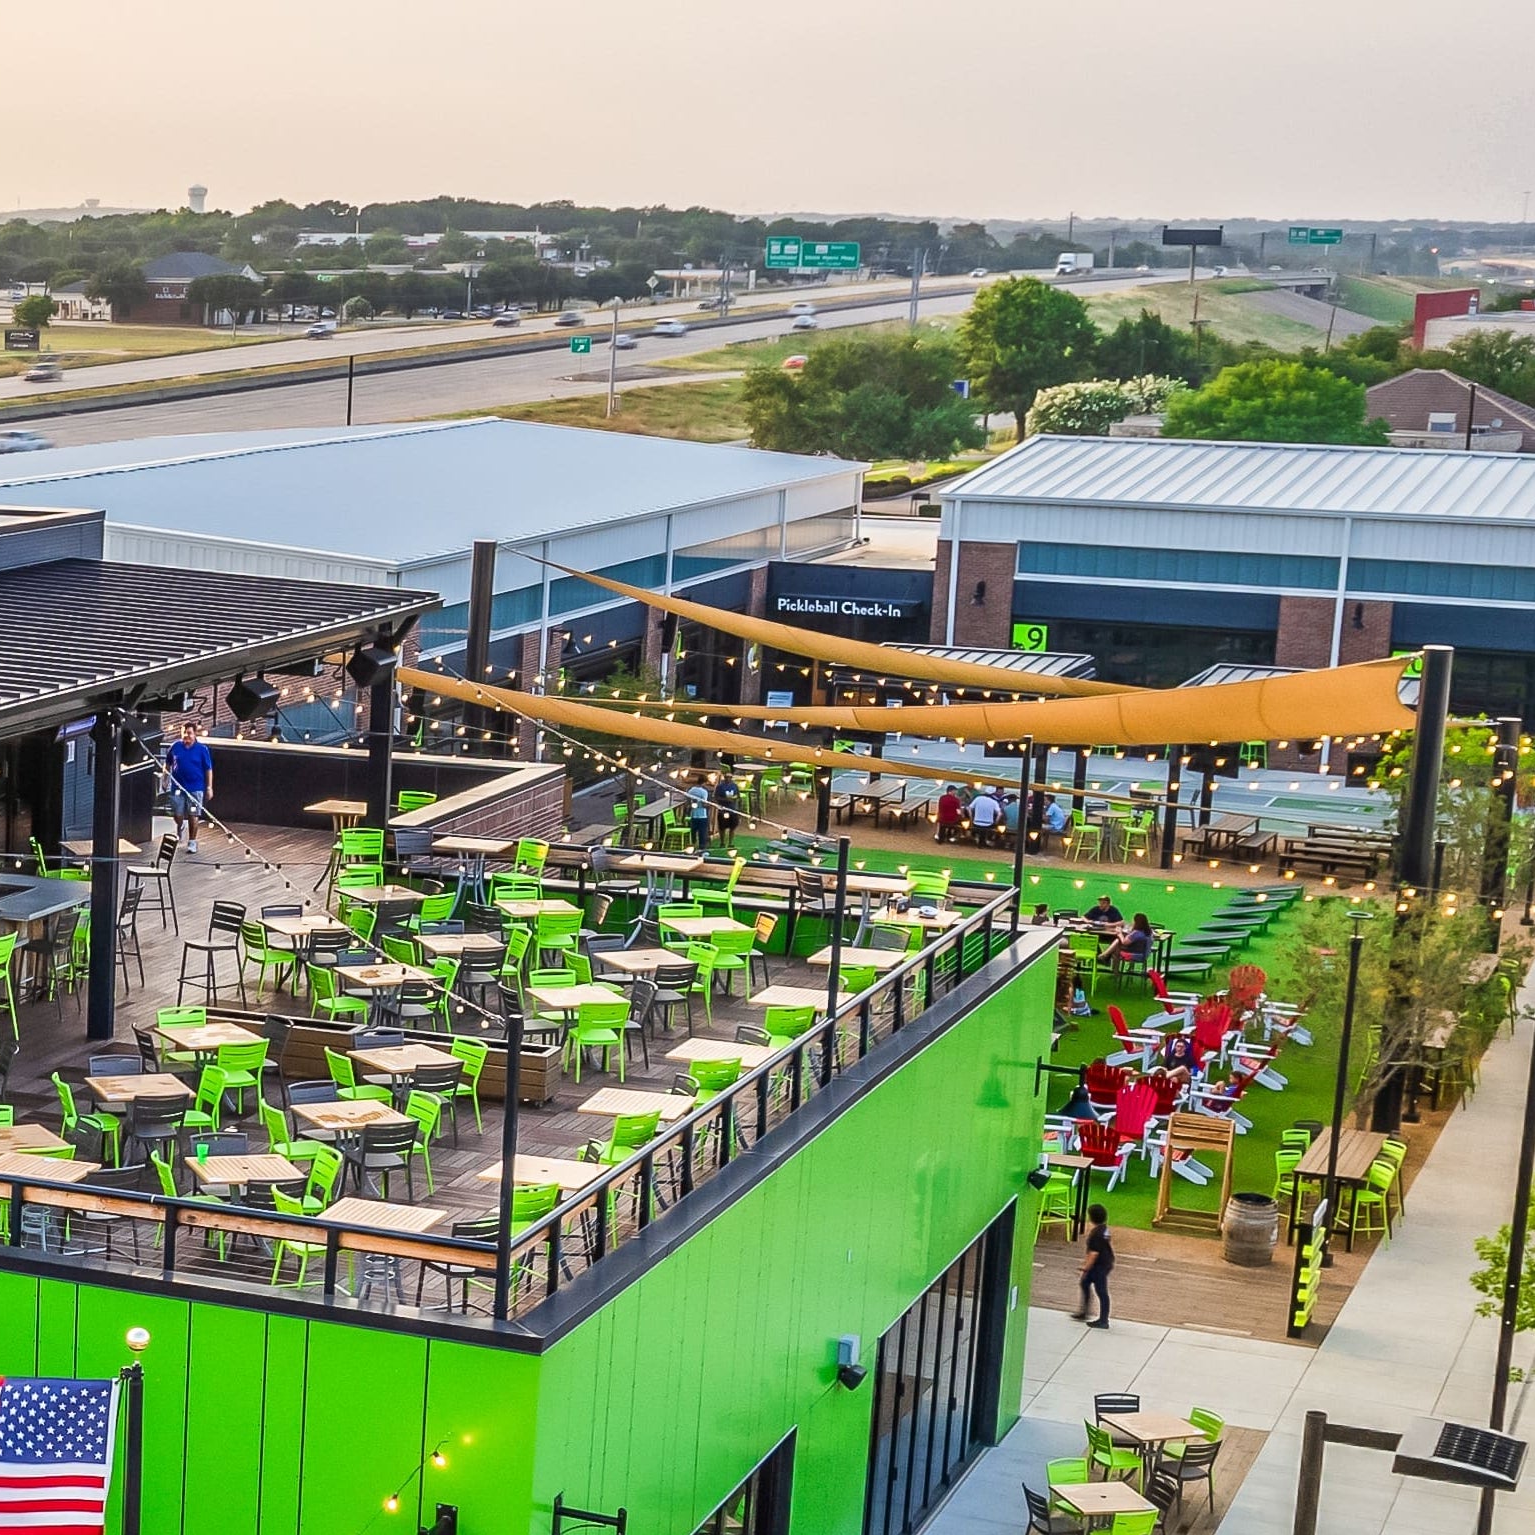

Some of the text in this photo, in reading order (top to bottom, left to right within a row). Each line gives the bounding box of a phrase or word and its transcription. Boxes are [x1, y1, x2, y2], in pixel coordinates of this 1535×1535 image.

[777, 598, 901, 617] Pickleball Check-In
[1027, 627, 1043, 650] 9
